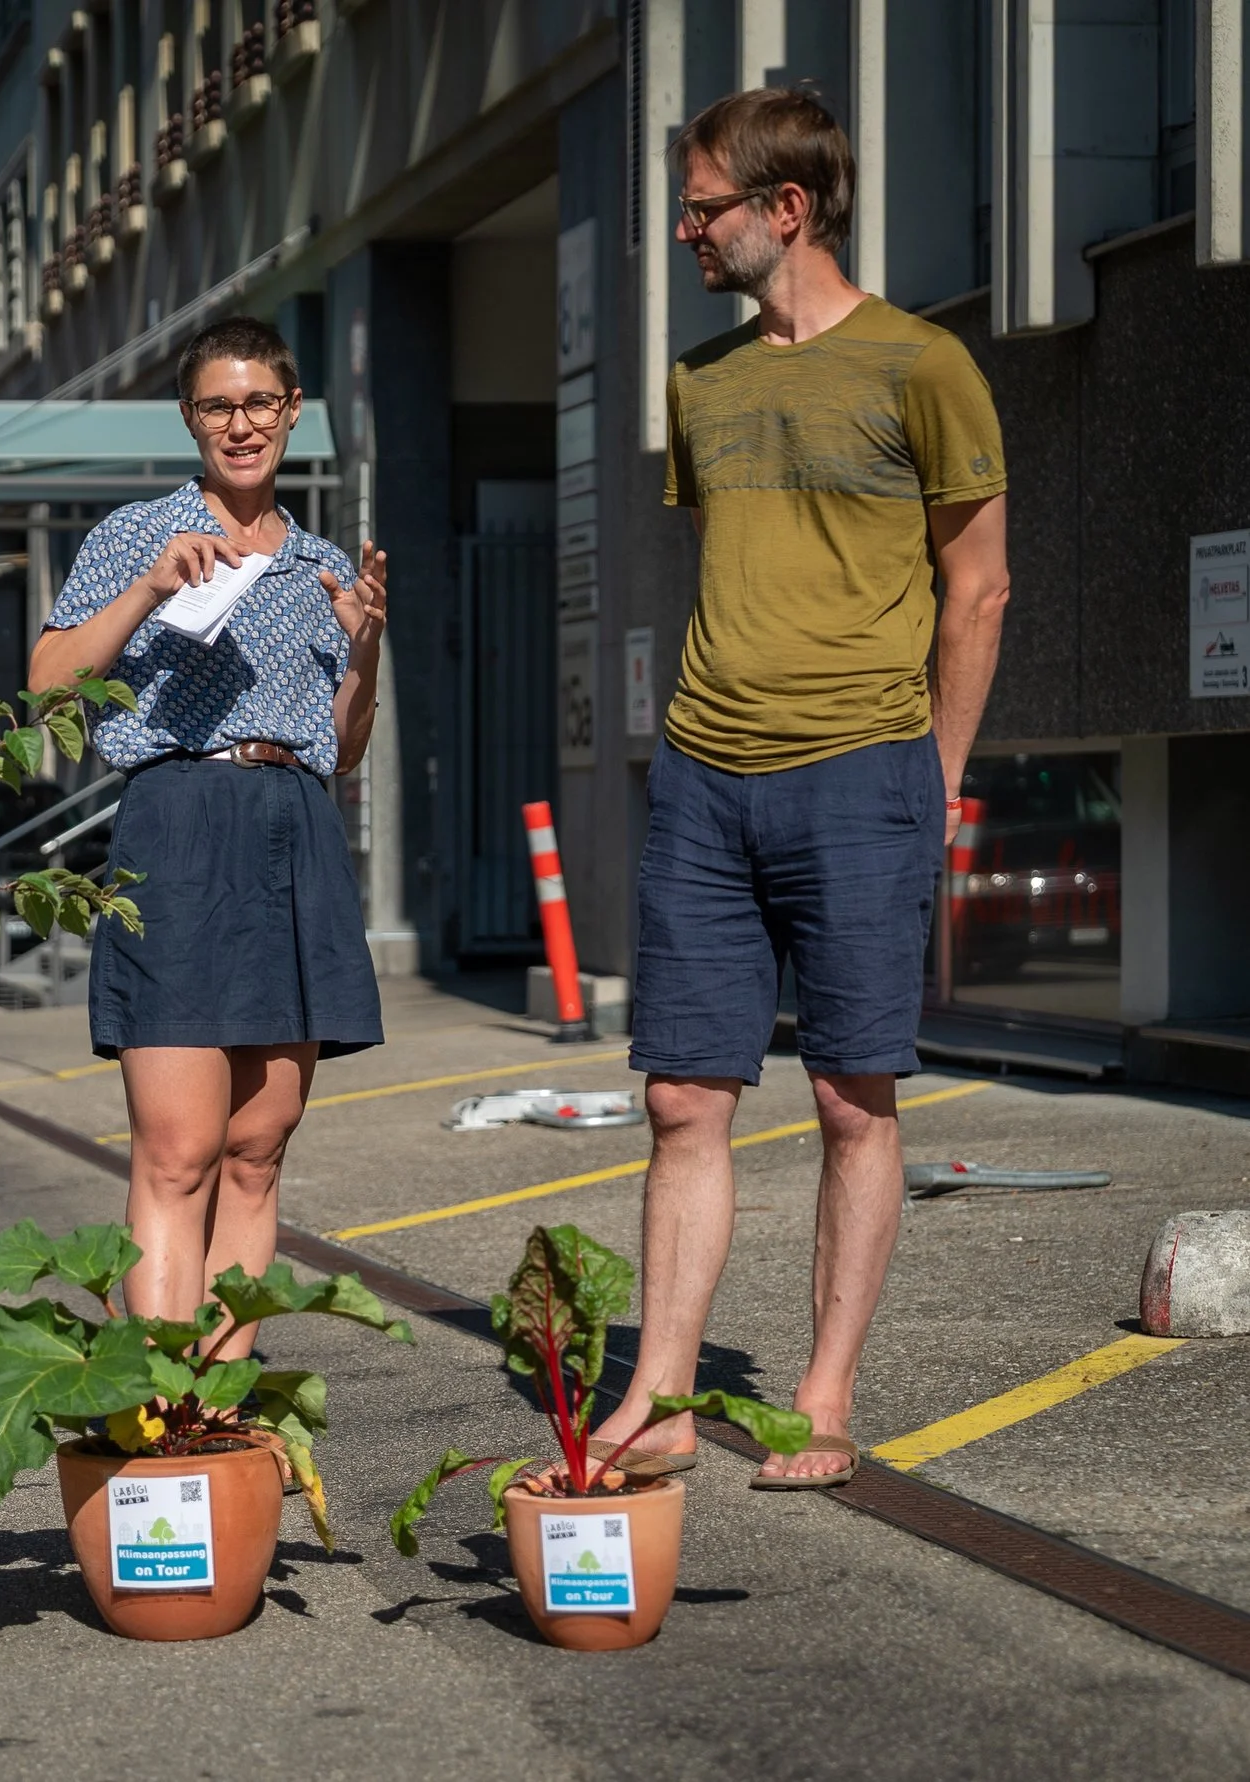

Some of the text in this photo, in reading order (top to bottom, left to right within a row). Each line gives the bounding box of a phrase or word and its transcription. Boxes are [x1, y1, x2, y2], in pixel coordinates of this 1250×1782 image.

[116, 1496, 148, 1506] STADT
[119, 1549, 206, 1561] Klimaanpassung
[134, 1564, 190, 1576] on Tour
[551, 1577, 627, 1588] Klimaanpassung
[565, 1590, 614, 1601] on Tour
